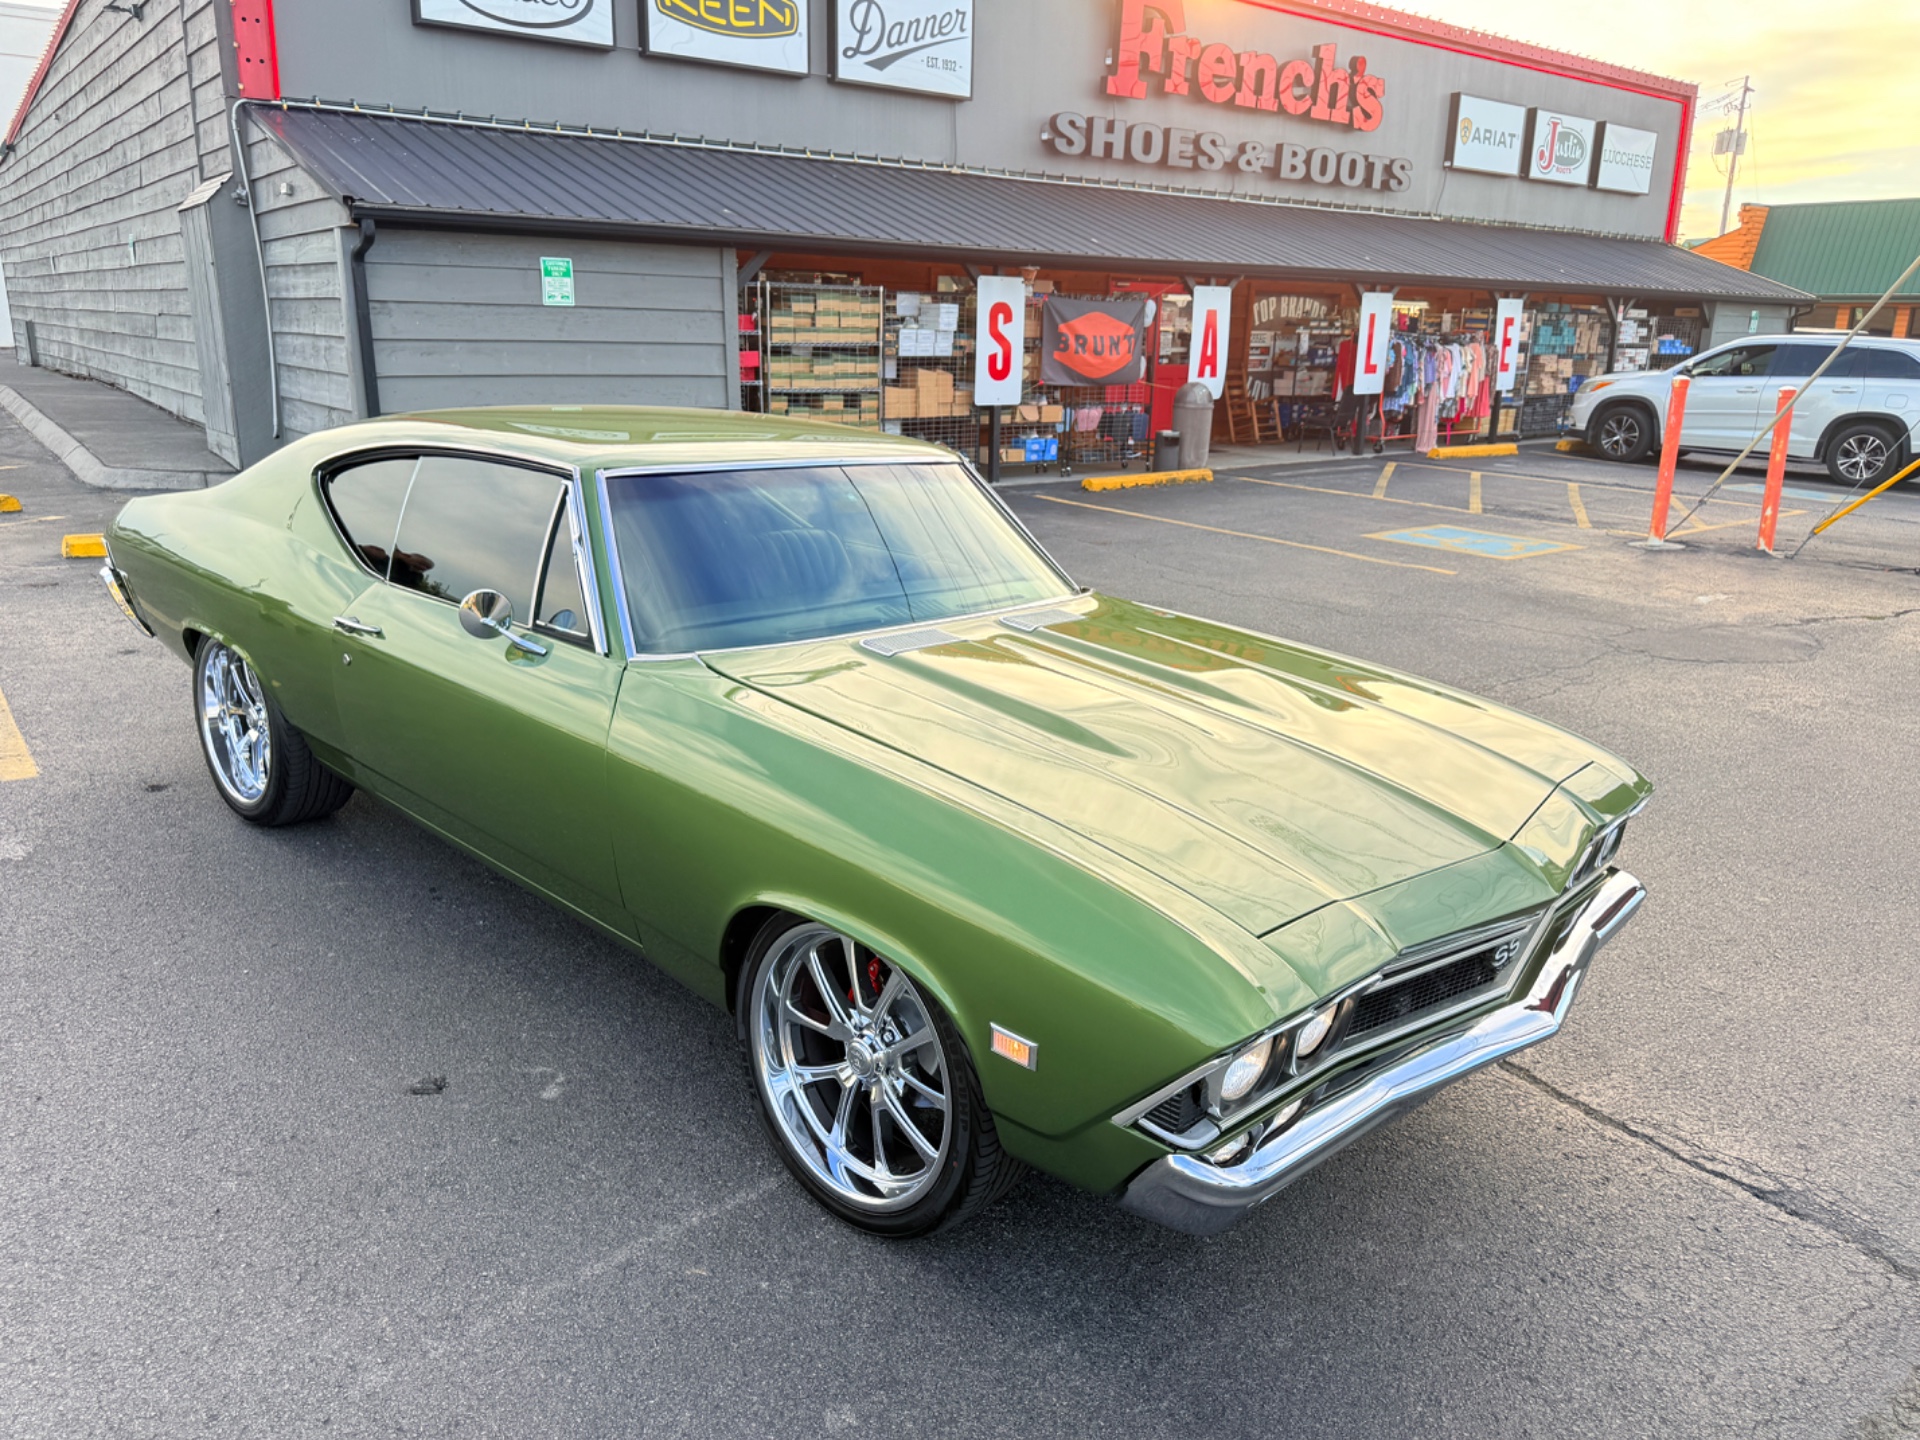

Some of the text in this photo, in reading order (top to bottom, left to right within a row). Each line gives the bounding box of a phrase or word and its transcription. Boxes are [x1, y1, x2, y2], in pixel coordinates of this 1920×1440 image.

[842, 0, 966, 59] Danner
[1104, 0, 1386, 132] French's
[1051, 112, 1413, 192] SHOES & BOOTS
[1471, 128, 1516, 149] ARIAT
[1538, 120, 1583, 171] Justin
[1603, 148, 1652, 170] LUCCHESE
[1253, 297, 1277, 326] TOP
[1053, 332, 1136, 357] BRUNT
[1491, 938, 1520, 967] SS
